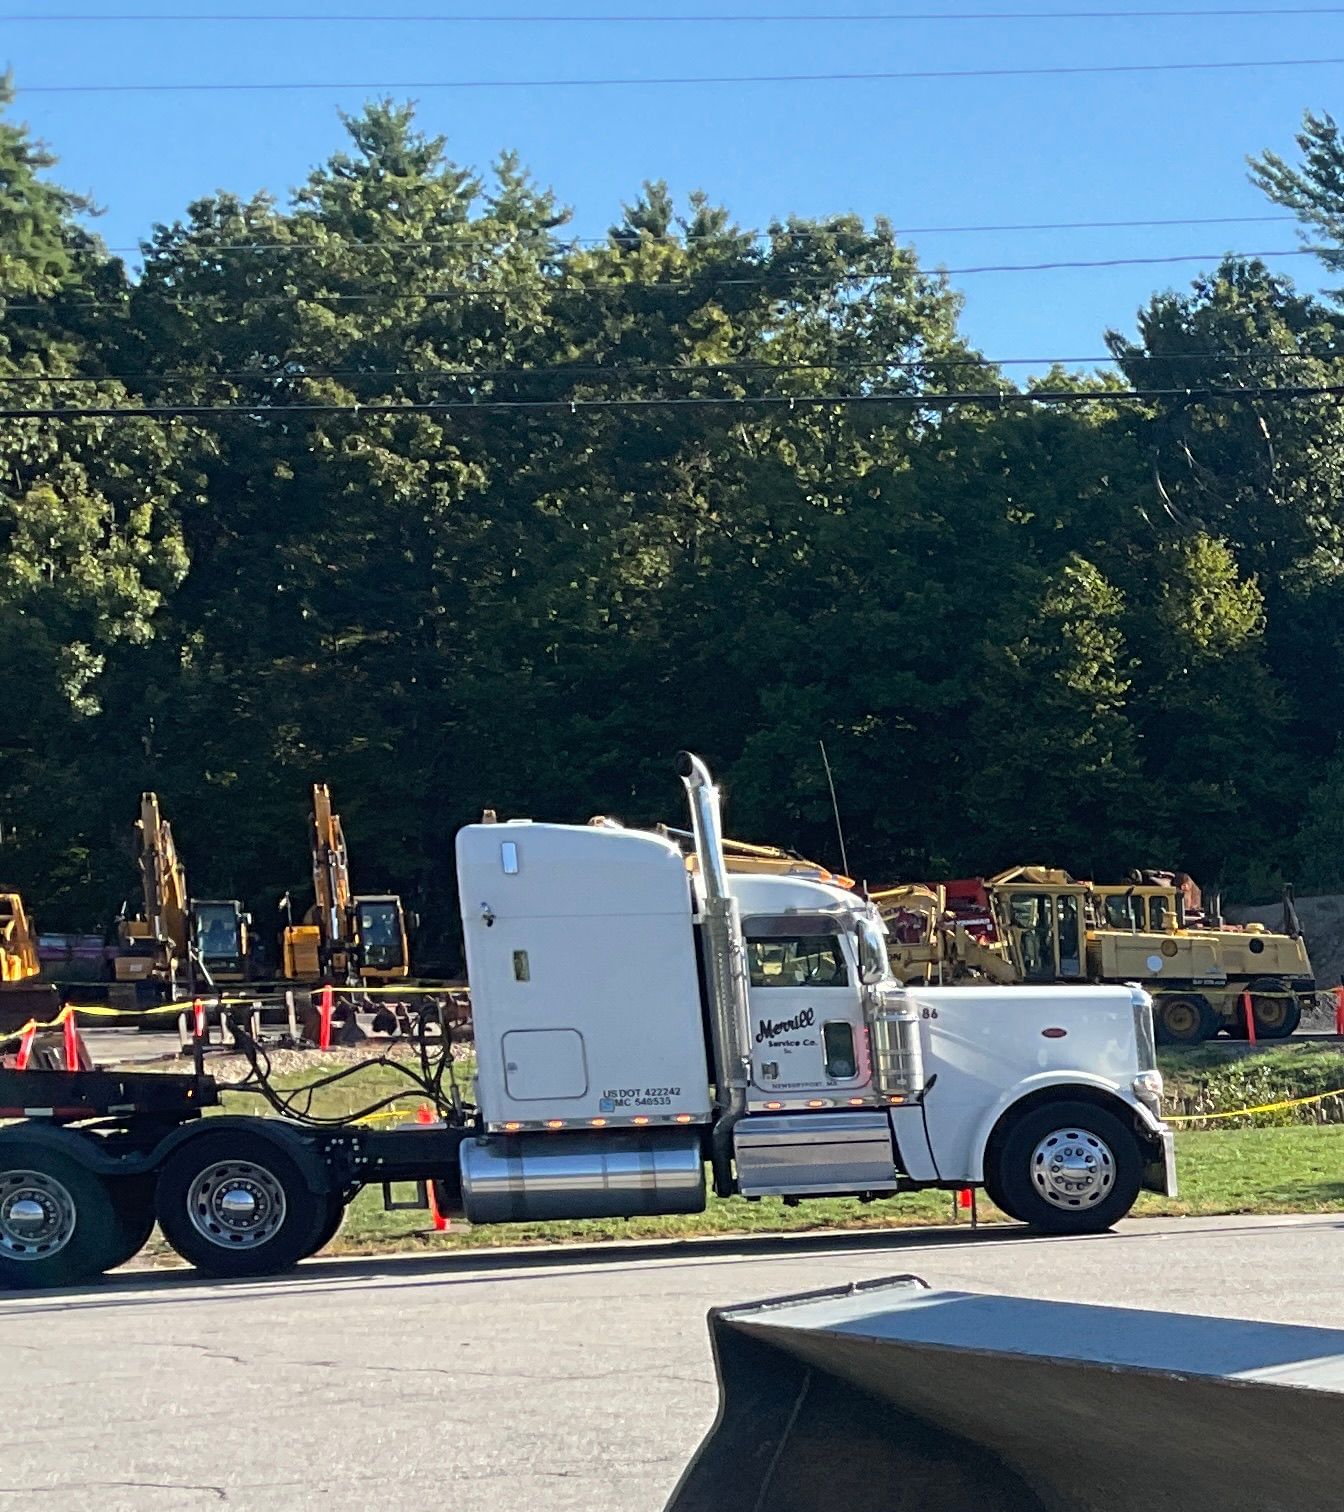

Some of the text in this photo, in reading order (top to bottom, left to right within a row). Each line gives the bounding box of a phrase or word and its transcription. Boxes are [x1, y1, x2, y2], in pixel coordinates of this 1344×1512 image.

[756, 1007, 816, 1043] Merrill
[645, 1087, 681, 1097] 422242
[615, 1098, 631, 1107] MC
